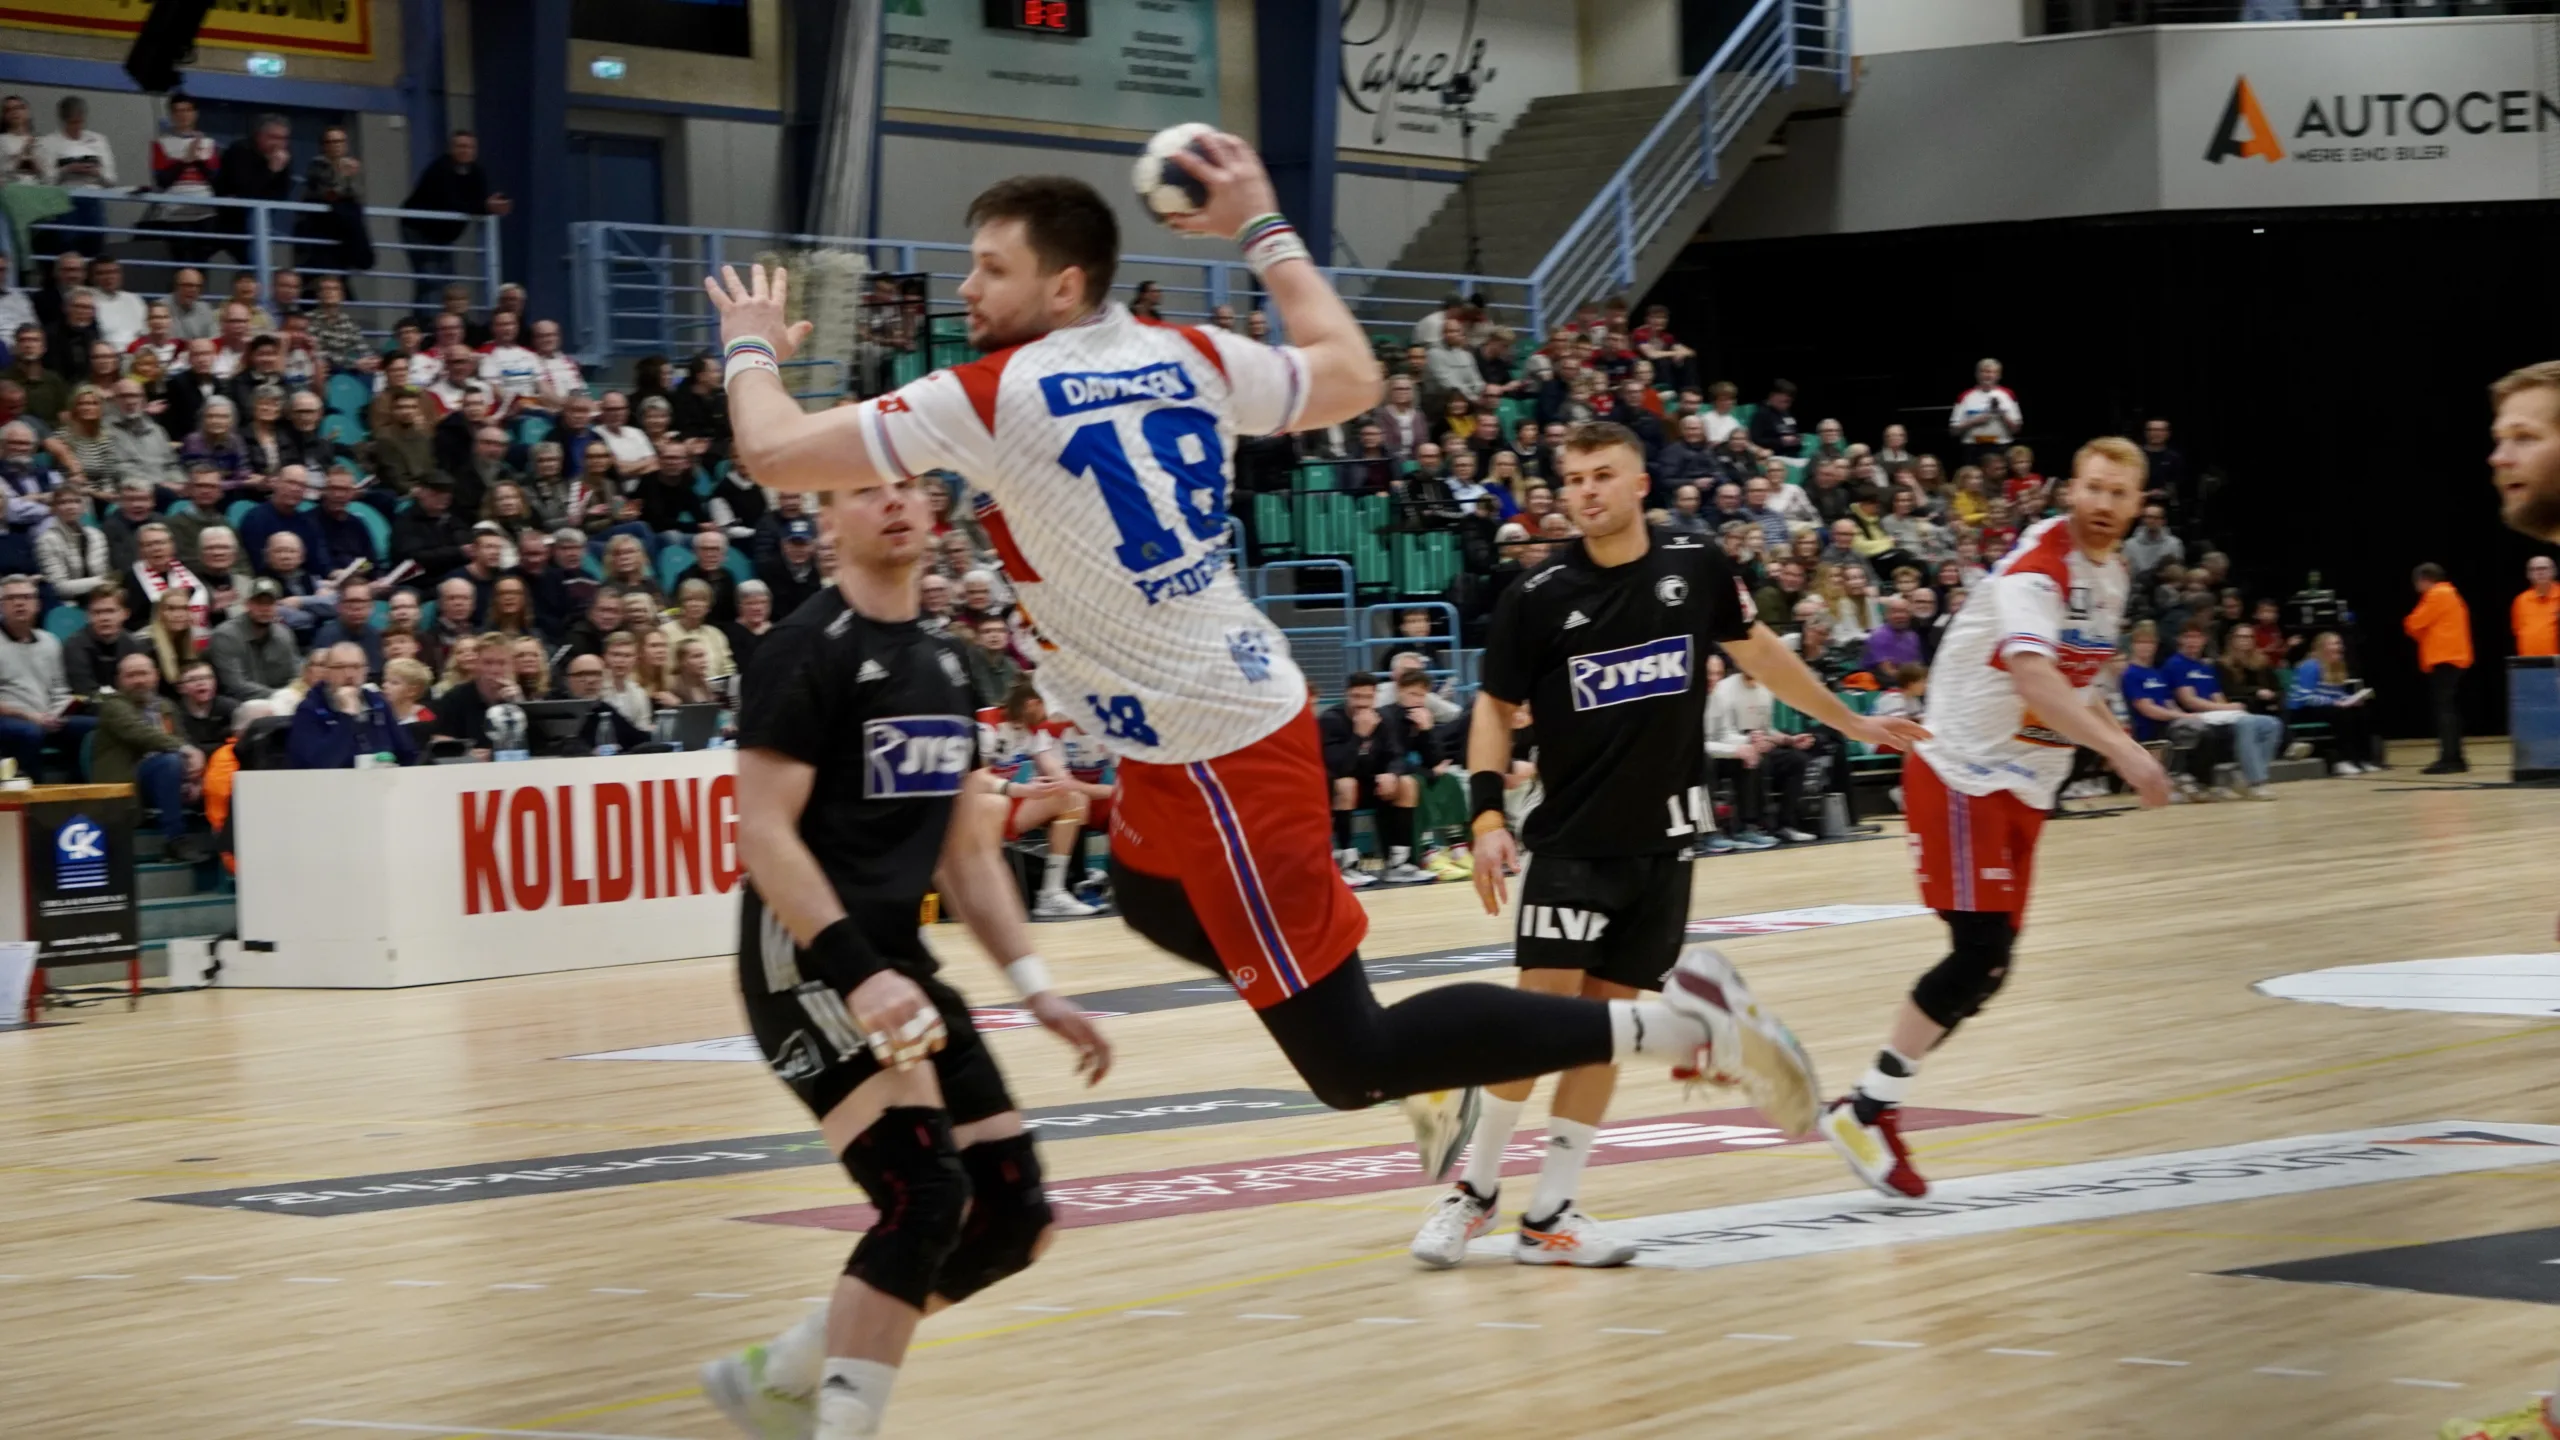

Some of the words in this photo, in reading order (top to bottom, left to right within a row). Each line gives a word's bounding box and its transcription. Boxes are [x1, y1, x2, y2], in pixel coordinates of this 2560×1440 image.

[1058, 406, 1229, 573] 18
[1598, 650, 1688, 690] JYSK
[1085, 694, 1160, 747] 18
[898, 735, 973, 775] JYS
[460, 774, 744, 915] KOLDING
